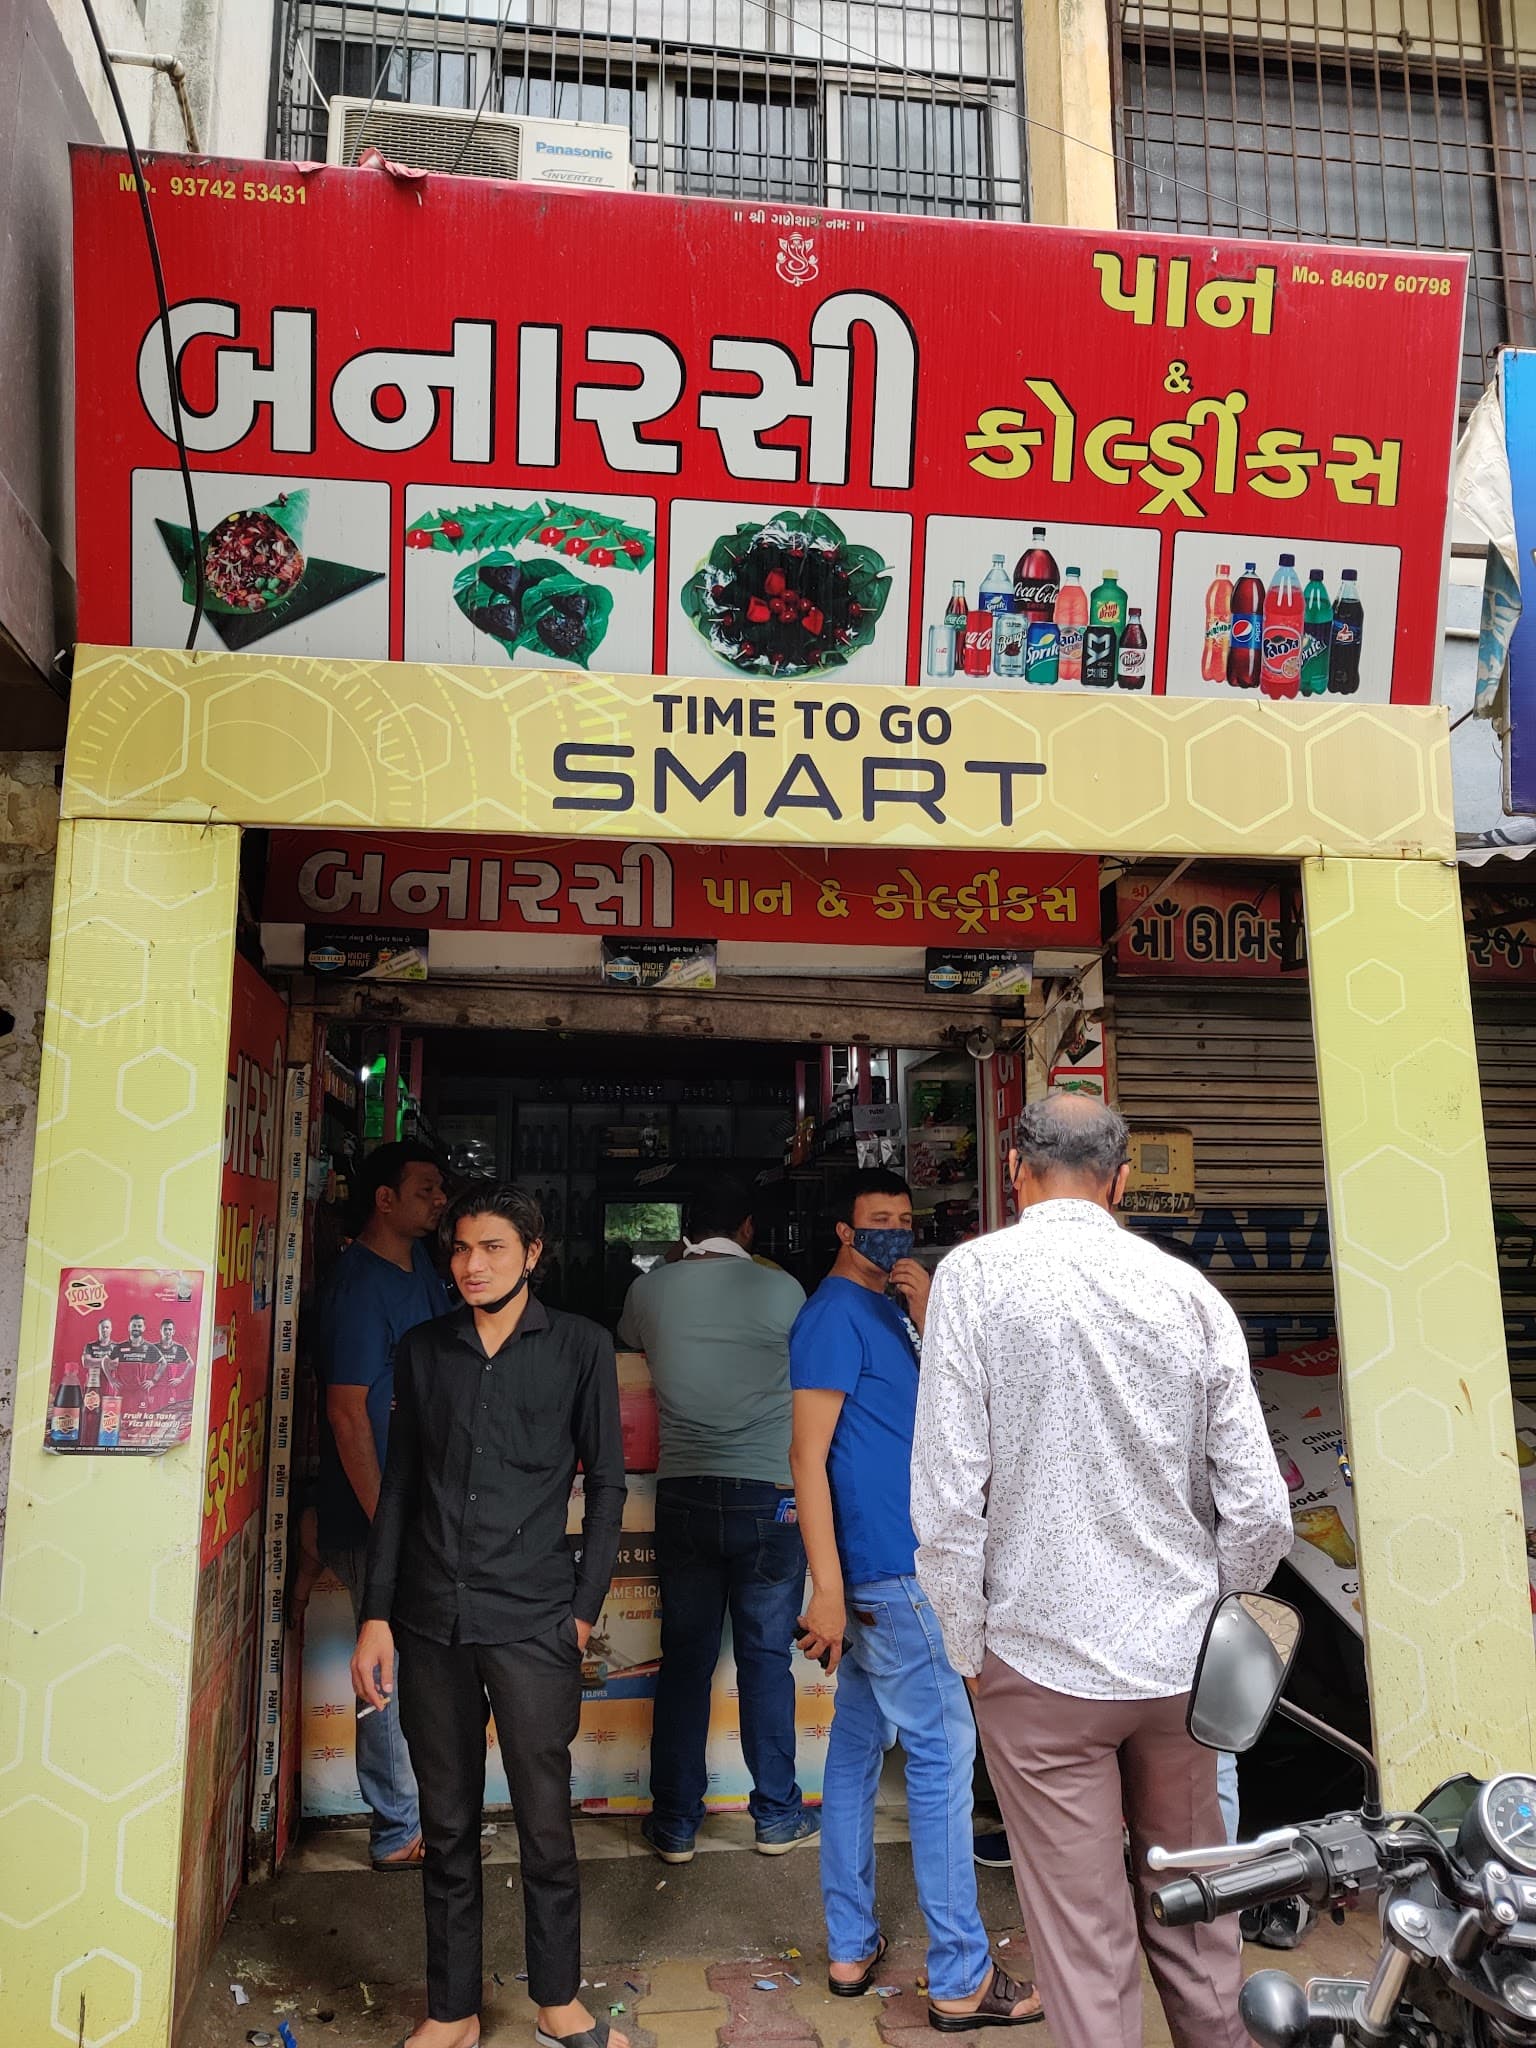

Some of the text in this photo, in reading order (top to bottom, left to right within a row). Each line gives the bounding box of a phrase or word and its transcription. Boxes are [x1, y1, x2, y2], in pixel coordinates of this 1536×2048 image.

[536, 141, 613, 160] Panasonic
[170, 176, 237, 199] 93742
[243, 182, 307, 205] 53431
[547, 171, 604, 184] INVERTER
[1093, 250, 1277, 335] પાન
[1292, 265, 1451, 296] Mo. 84607 60798
[137, 289, 918, 491] બનારસી
[1163, 361, 1193, 394] &
[1027, 640, 1060, 664] Sprite
[1263, 638, 1300, 659] Fanta
[1300, 638, 1329, 667] prite
[653, 694, 952, 746] TIME TO GO
[552, 742, 1047, 827] SMART
[298, 842, 674, 928] બનારસી
[703, 877, 792, 917] પાન
[816, 878, 850, 918] &
[296, 1071, 305, 1098] Paytm
[223, 1039, 284, 1181] નારસી
[294, 1111, 302, 1137] Paytm
[293, 1151, 301, 1178] Paytm
[290, 1191, 299, 1218] Paytm
[218, 1203, 254, 1289] પાન
[287, 1232, 296, 1260] Paytm
[71, 1286, 103, 1303] SOSYO
[286, 1274, 294, 1305] Paytm
[227, 1310, 237, 1364] &
[282, 1320, 292, 1352] Paytm
[280, 1367, 290, 1400] Paytm
[123, 1412, 142, 1420] Fruit
[278, 1416, 287, 1448] Paytm
[1302, 1429, 1343, 1446] Chiku
[204, 1368, 268, 1547] લ્ડ્રીંકસ
[275, 1464, 285, 1497] Paytm
[273, 1540, 281, 1573] Paytm
[272, 1589, 281, 1623] Paytm
[269, 1639, 280, 1673] Paytm
[267, 1689, 277, 1724] Paytm
[263, 1741, 274, 1776] Paytm
[259, 1792, 271, 1830] Paytm
